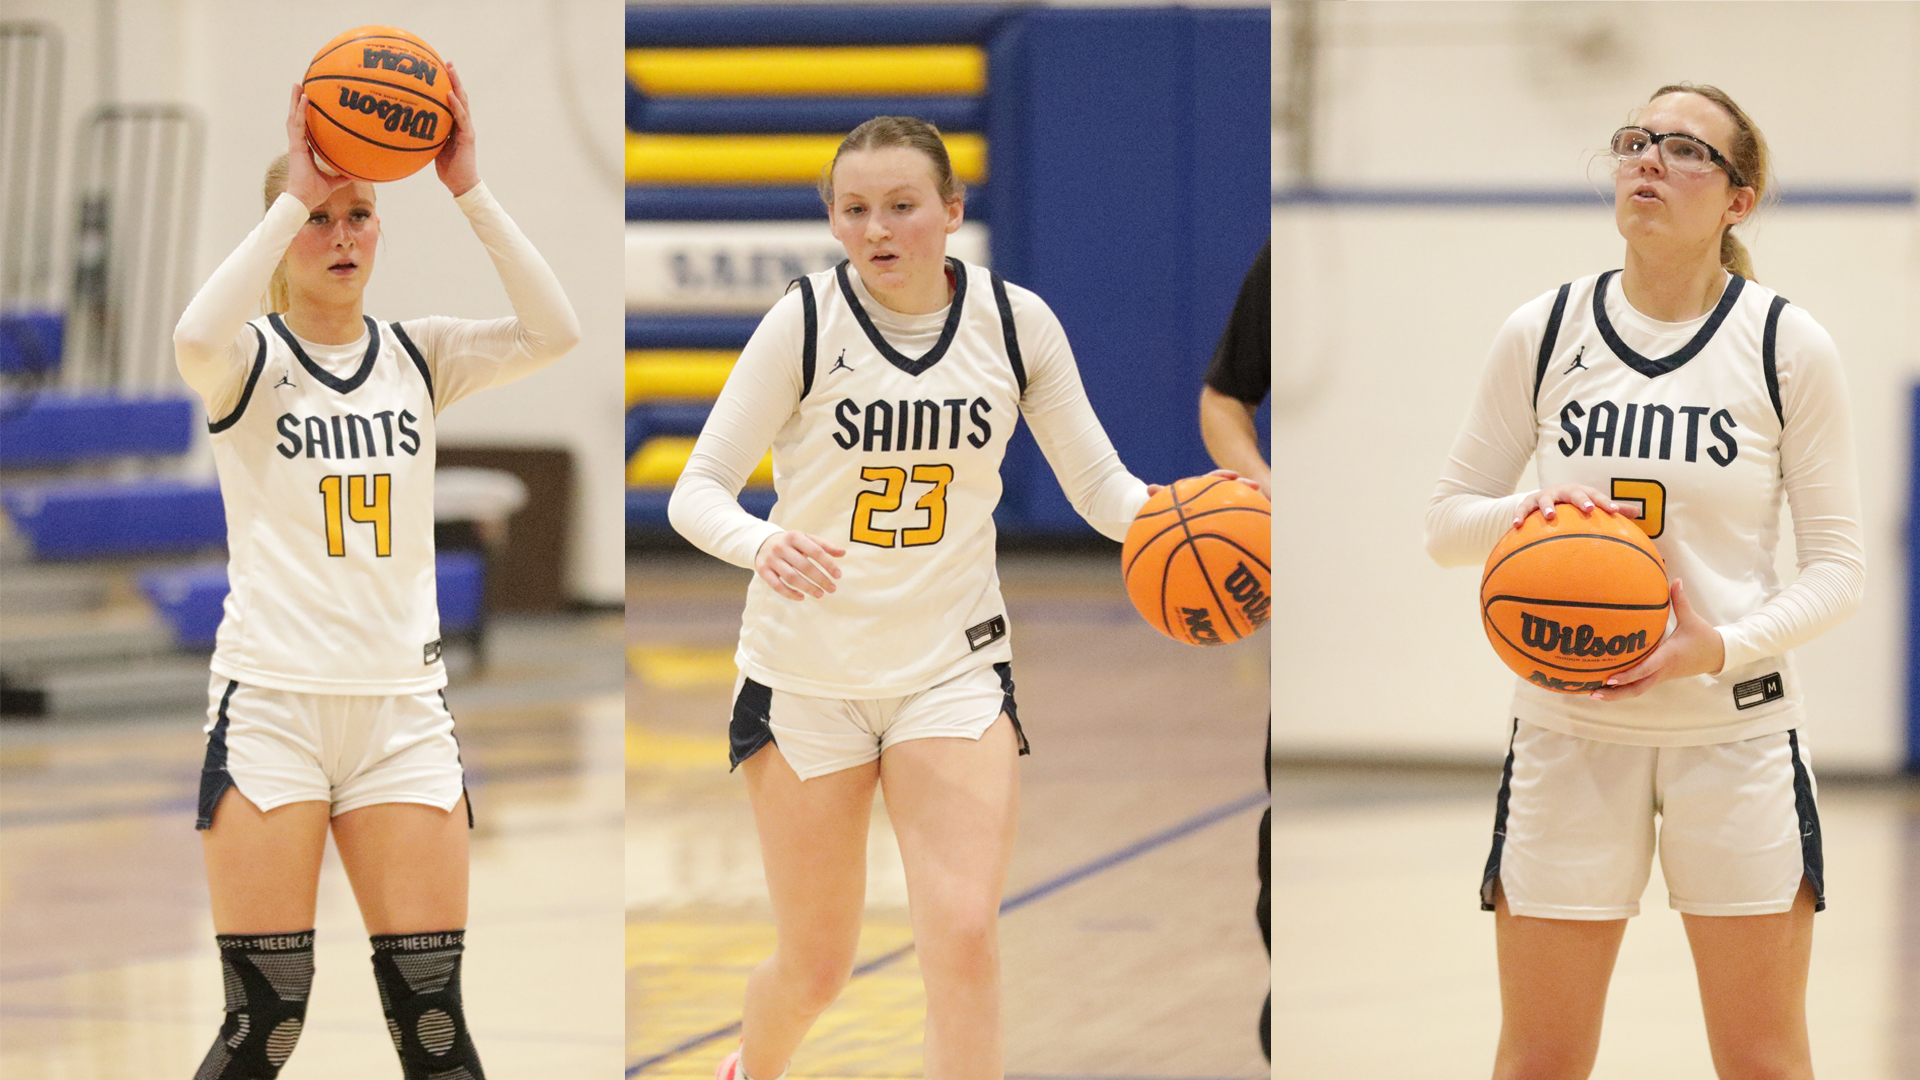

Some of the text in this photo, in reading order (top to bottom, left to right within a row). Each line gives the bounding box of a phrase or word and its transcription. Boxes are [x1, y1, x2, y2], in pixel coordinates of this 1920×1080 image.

[363, 48, 438, 87] NCAA
[339, 86, 438, 141] Wilson
[276, 408, 421, 460] SAINTS
[832, 396, 993, 452] SAINTS
[1558, 399, 1738, 467] SAINTS
[318, 473, 392, 558] 14
[849, 463, 955, 548] 23
[994, 624, 1001, 633] L
[1520, 611, 1647, 657] Wilson
[1527, 670, 1613, 692] NCA
[1767, 681, 1777, 694] M
